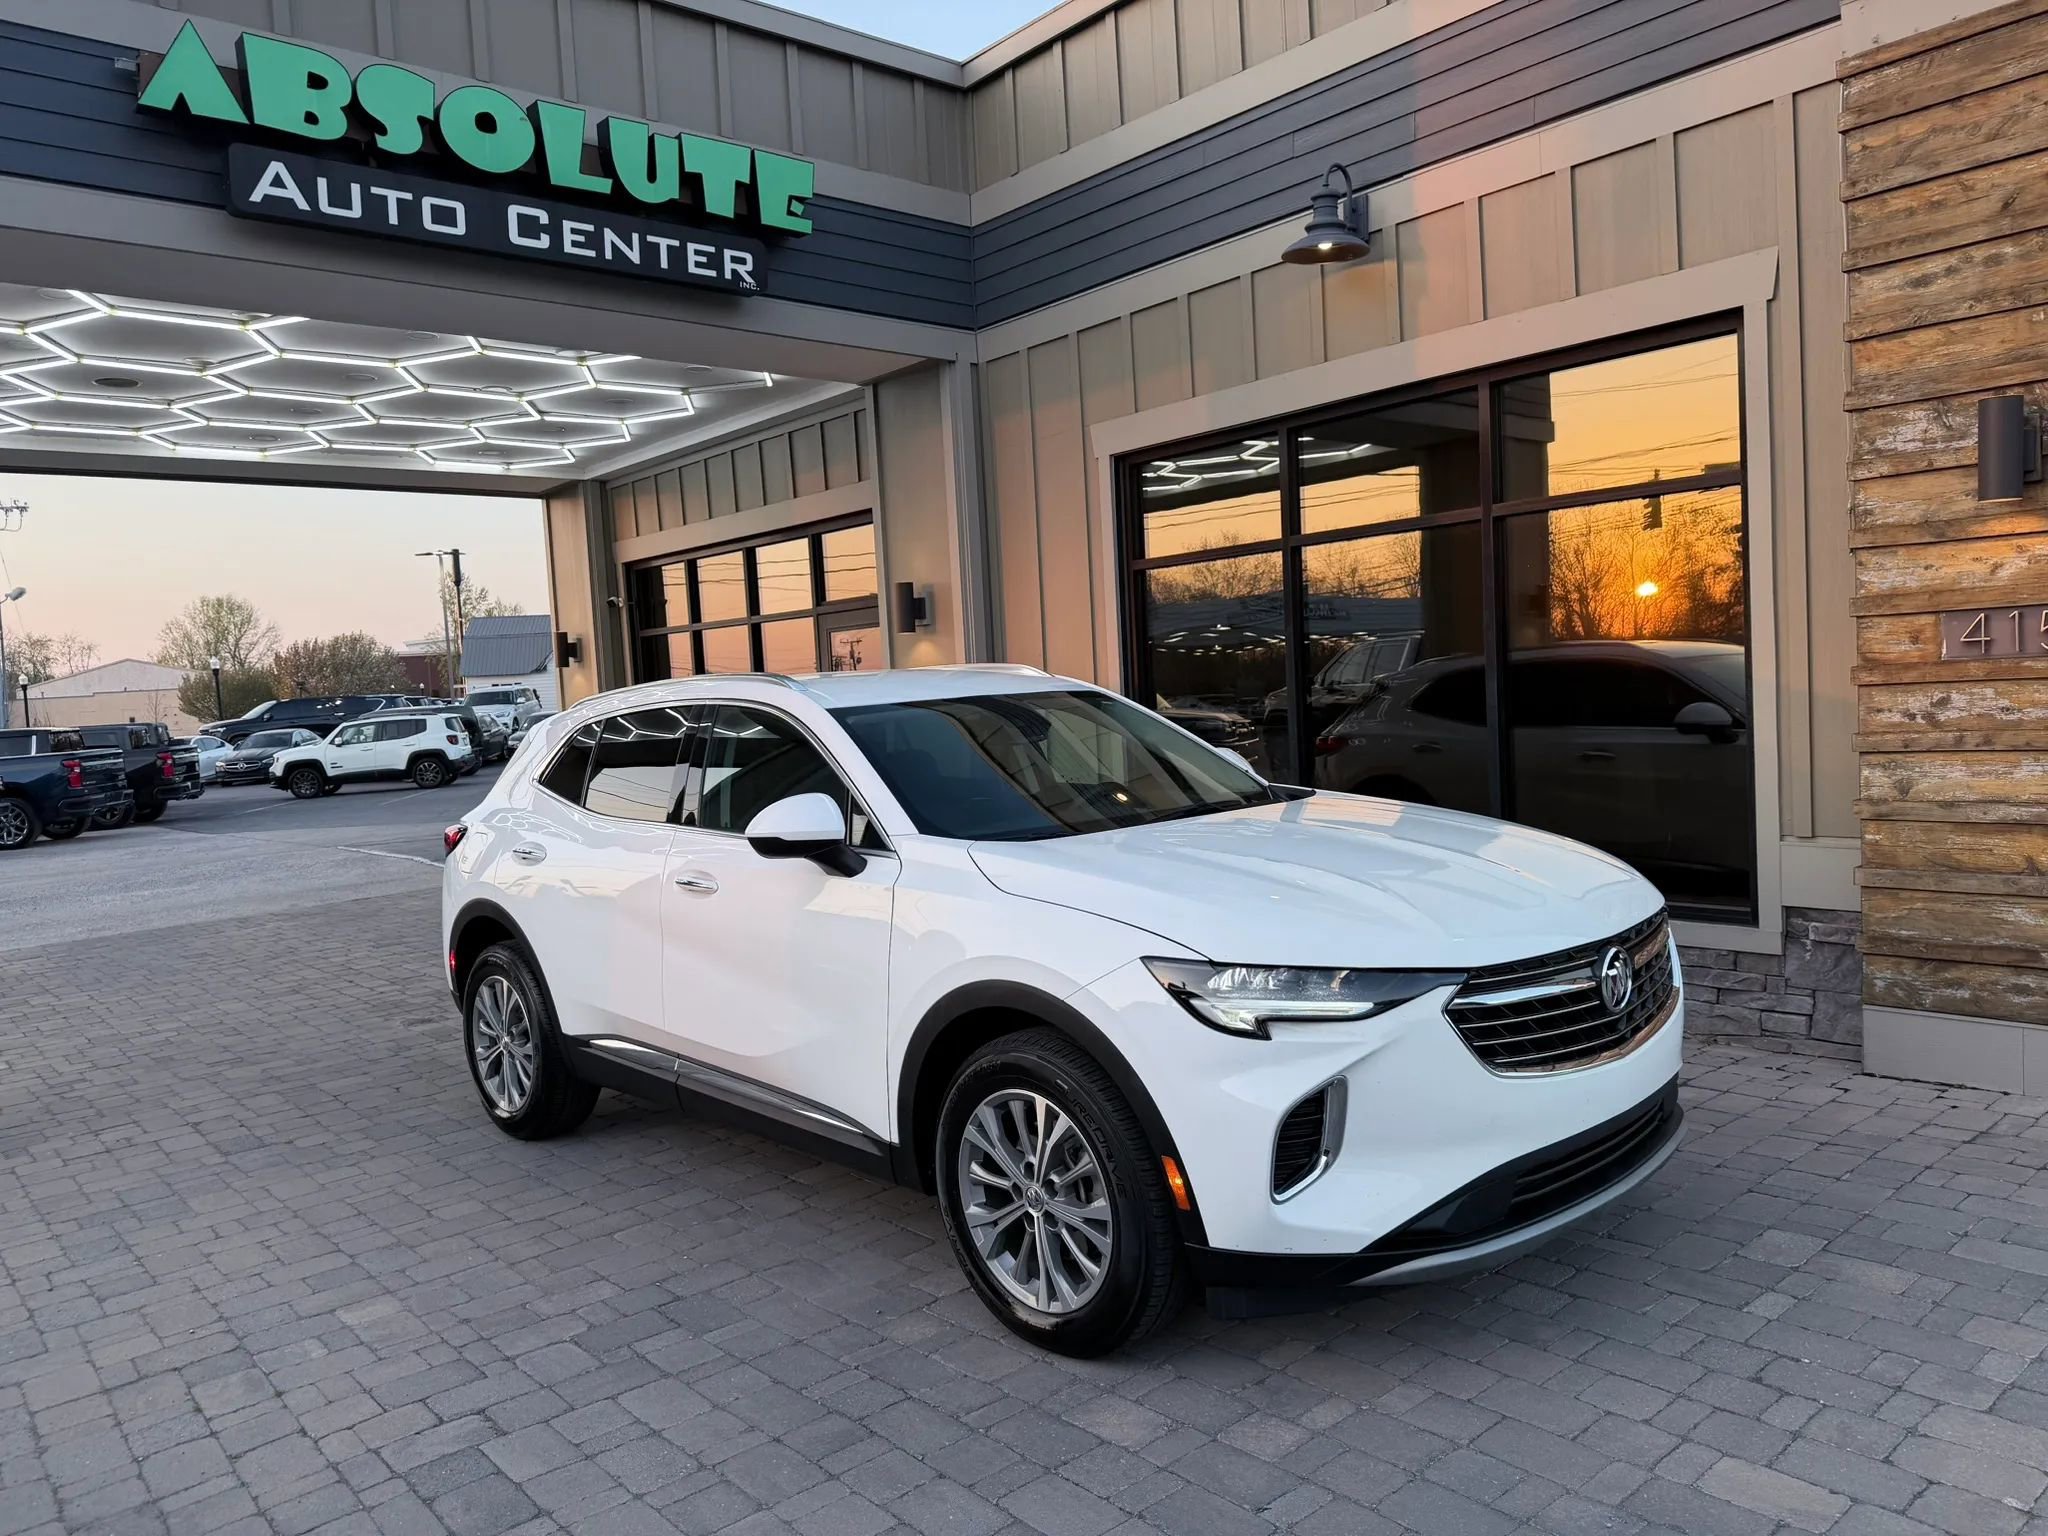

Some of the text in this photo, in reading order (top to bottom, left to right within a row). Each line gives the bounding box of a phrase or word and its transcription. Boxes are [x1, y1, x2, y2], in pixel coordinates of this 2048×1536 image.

[137, 19, 815, 234] ABSOLUTE
[248, 160, 754, 284] AUTO CENTER
[739, 280, 760, 291] INC.
